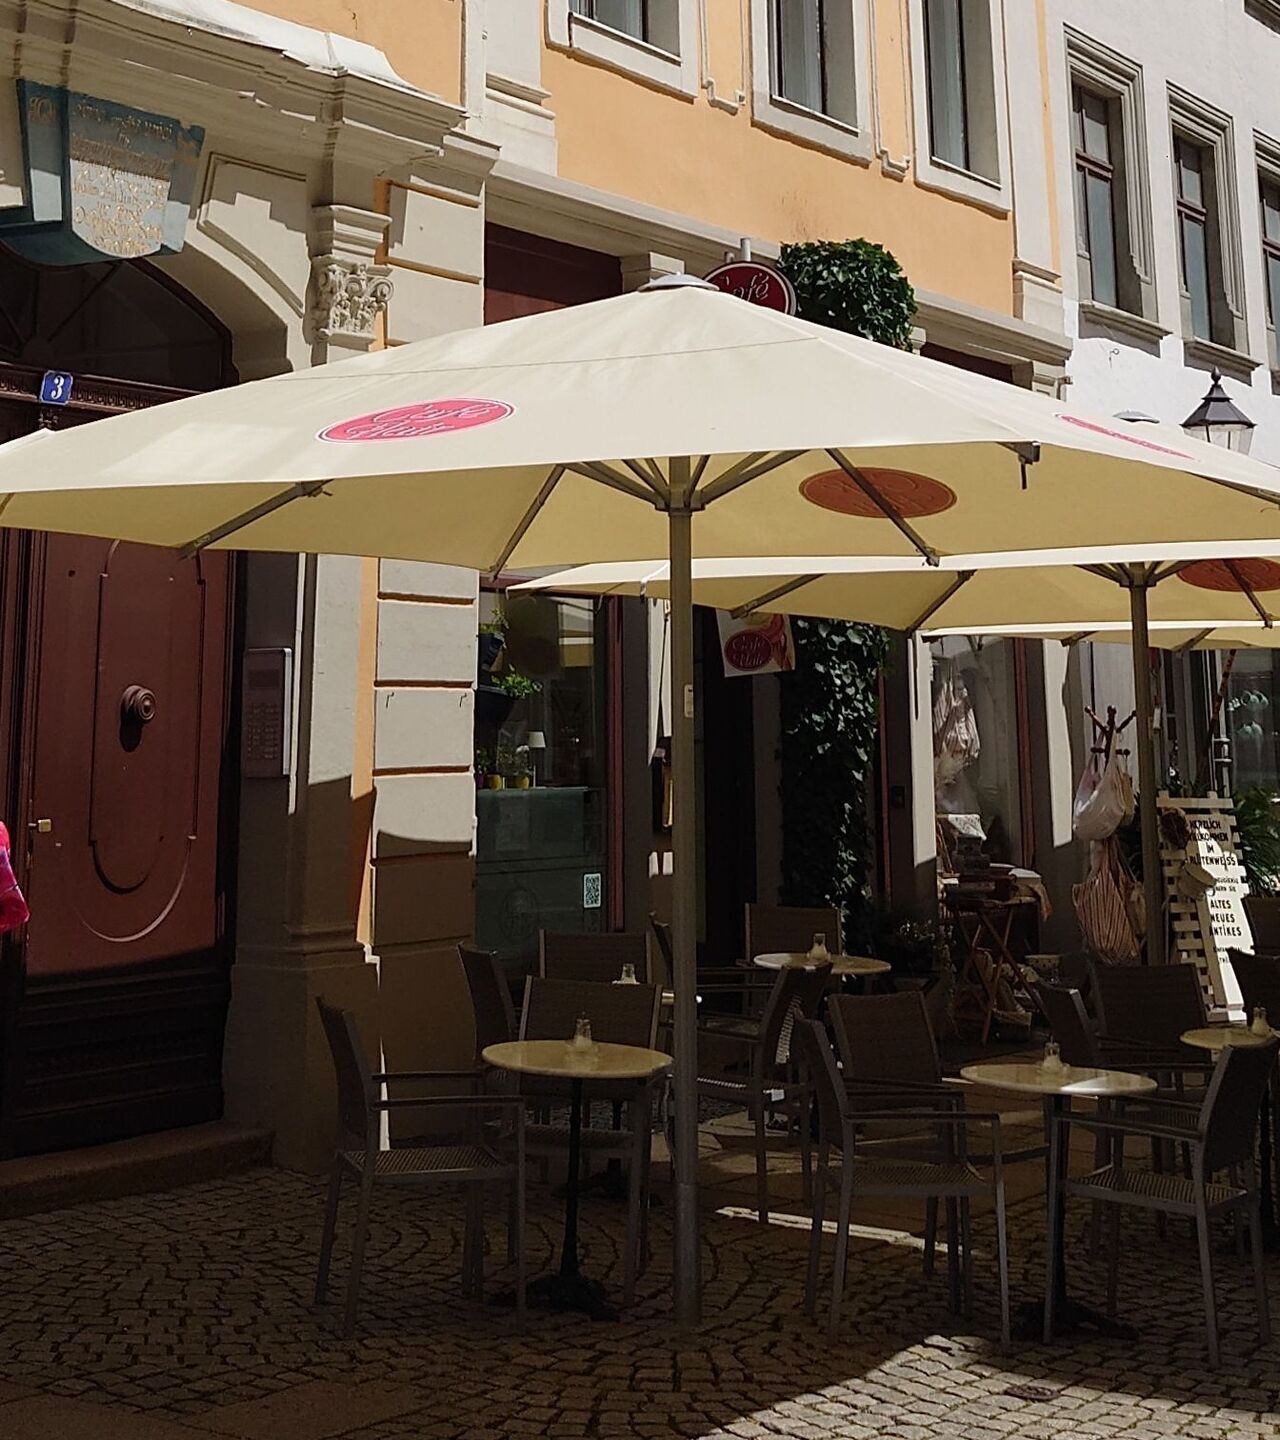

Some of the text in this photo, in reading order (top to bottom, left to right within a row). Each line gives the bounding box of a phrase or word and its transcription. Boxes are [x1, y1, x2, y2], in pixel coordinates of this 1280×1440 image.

[51, 375, 65, 400] 3
[1210, 899, 1232, 910] ALTES
[1210, 913, 1235, 924] NEUES
